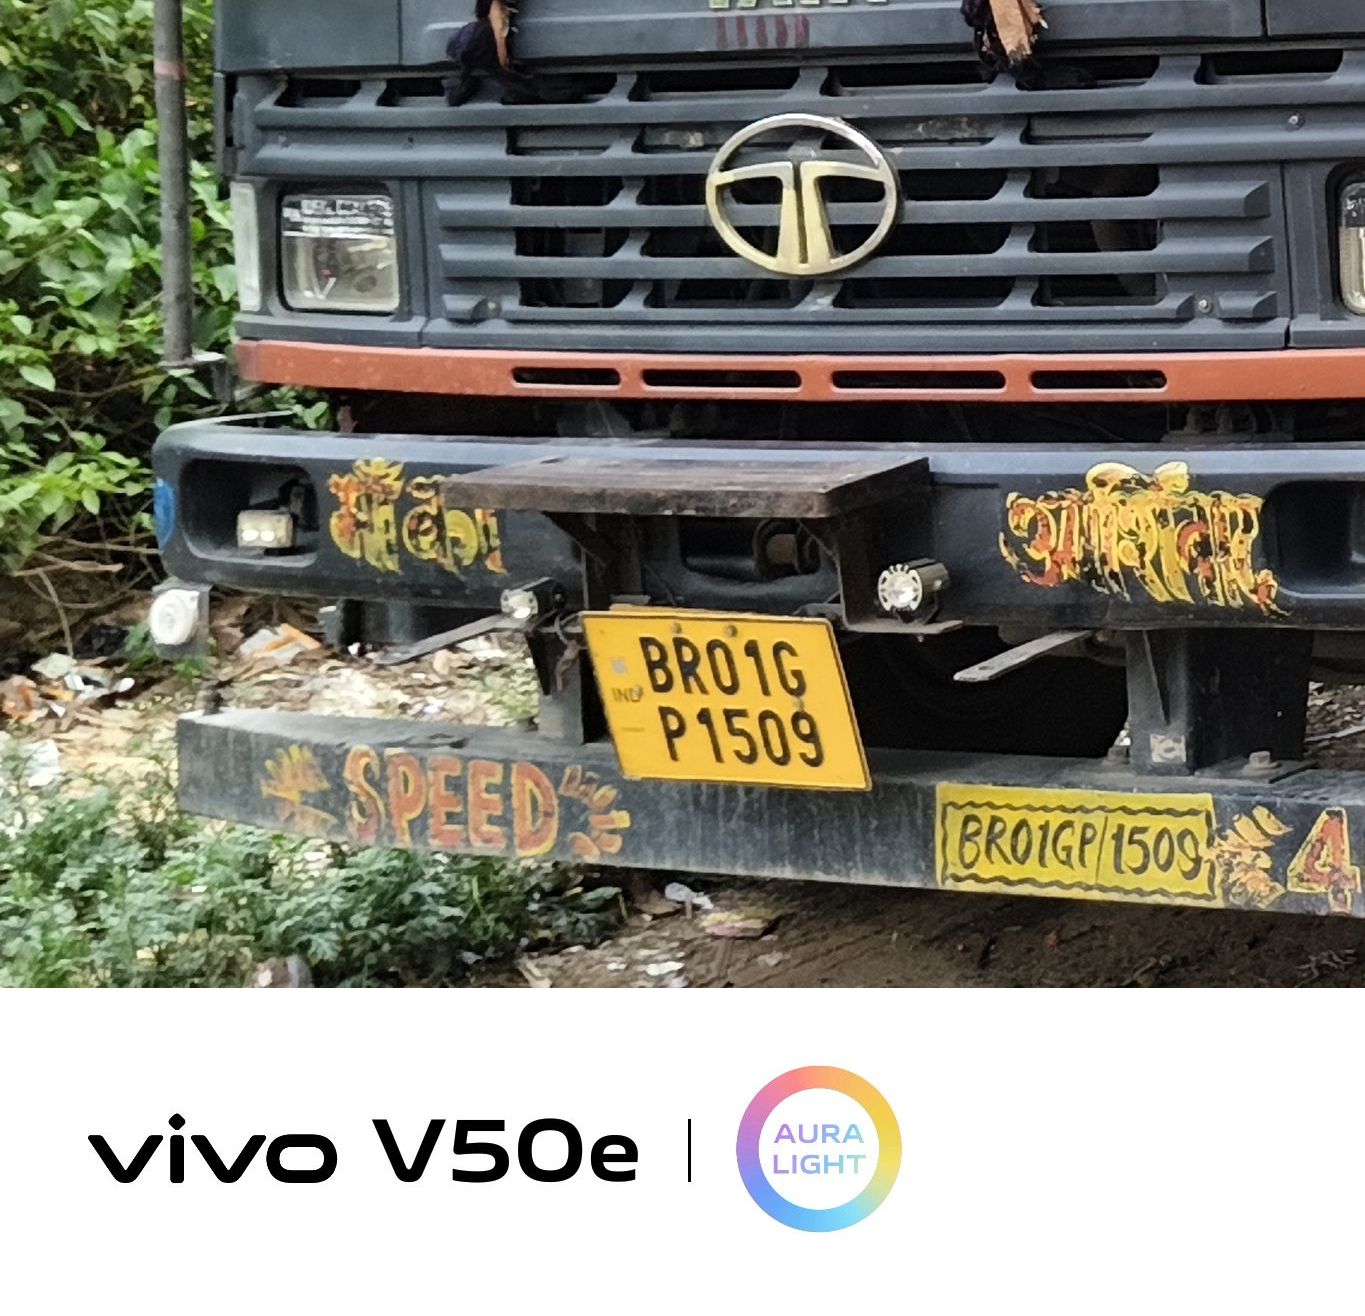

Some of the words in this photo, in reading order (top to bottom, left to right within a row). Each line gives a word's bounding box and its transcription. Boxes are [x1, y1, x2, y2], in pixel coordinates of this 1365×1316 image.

[638, 636, 807, 697] BR01G
[658, 705, 825, 768] P1509
[342, 744, 558, 859] SPEED
